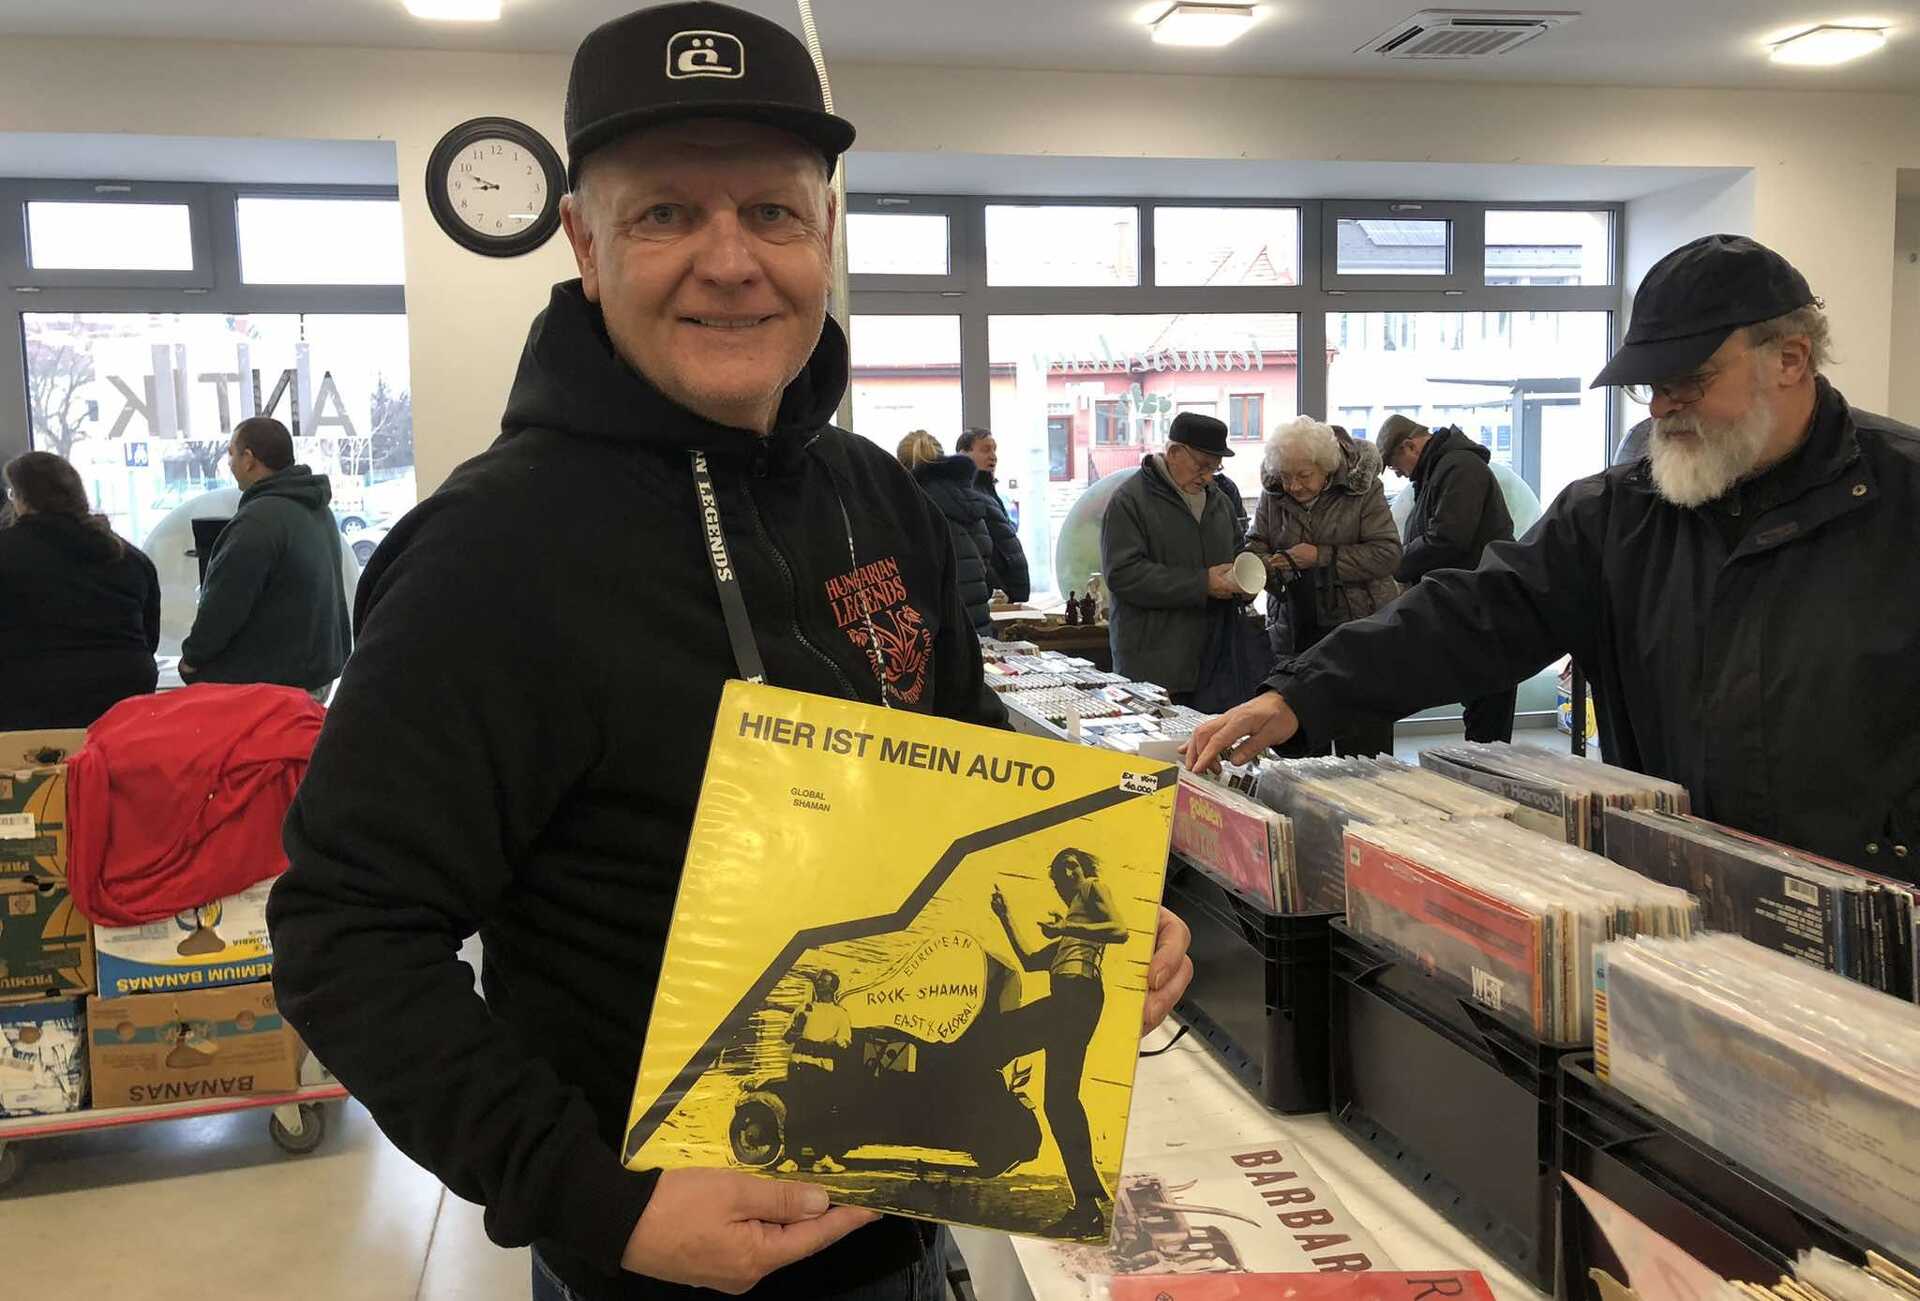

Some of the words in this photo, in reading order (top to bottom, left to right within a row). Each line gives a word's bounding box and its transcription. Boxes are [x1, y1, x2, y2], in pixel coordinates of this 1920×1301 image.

[473, 150, 484, 161] 11
[490, 145, 503, 156] 12
[513, 152, 518, 161] 1
[460, 163, 473, 173] 10
[526, 166, 533, 176] 2
[454, 181, 462, 190] 9
[535, 183, 541, 193] 3
[460, 200, 468, 209] 8
[527, 202, 534, 211] 4
[476, 213, 485, 223] 7
[495, 219, 503, 229] 6
[698, 481, 733, 582] LEGENDS
[825, 556, 899, 601] HUNGARIAN
[831, 575, 907, 628] LEGENDS
[739, 712, 816, 749] HIER
[822, 726, 875, 759] IST
[879, 737, 961, 775] MEIN
[967, 754, 1056, 792] AUTO
[790, 787, 826, 801] GLOBAL
[793, 799, 831, 812] SHAMAN
[208, 962, 272, 982] REMIUM
[0, 975, 53, 988] PREMIU
[116, 970, 202, 993] BANANAS
[129, 1075, 254, 1102] BANANAS
[1231, 1150, 1372, 1273] BARBAR
